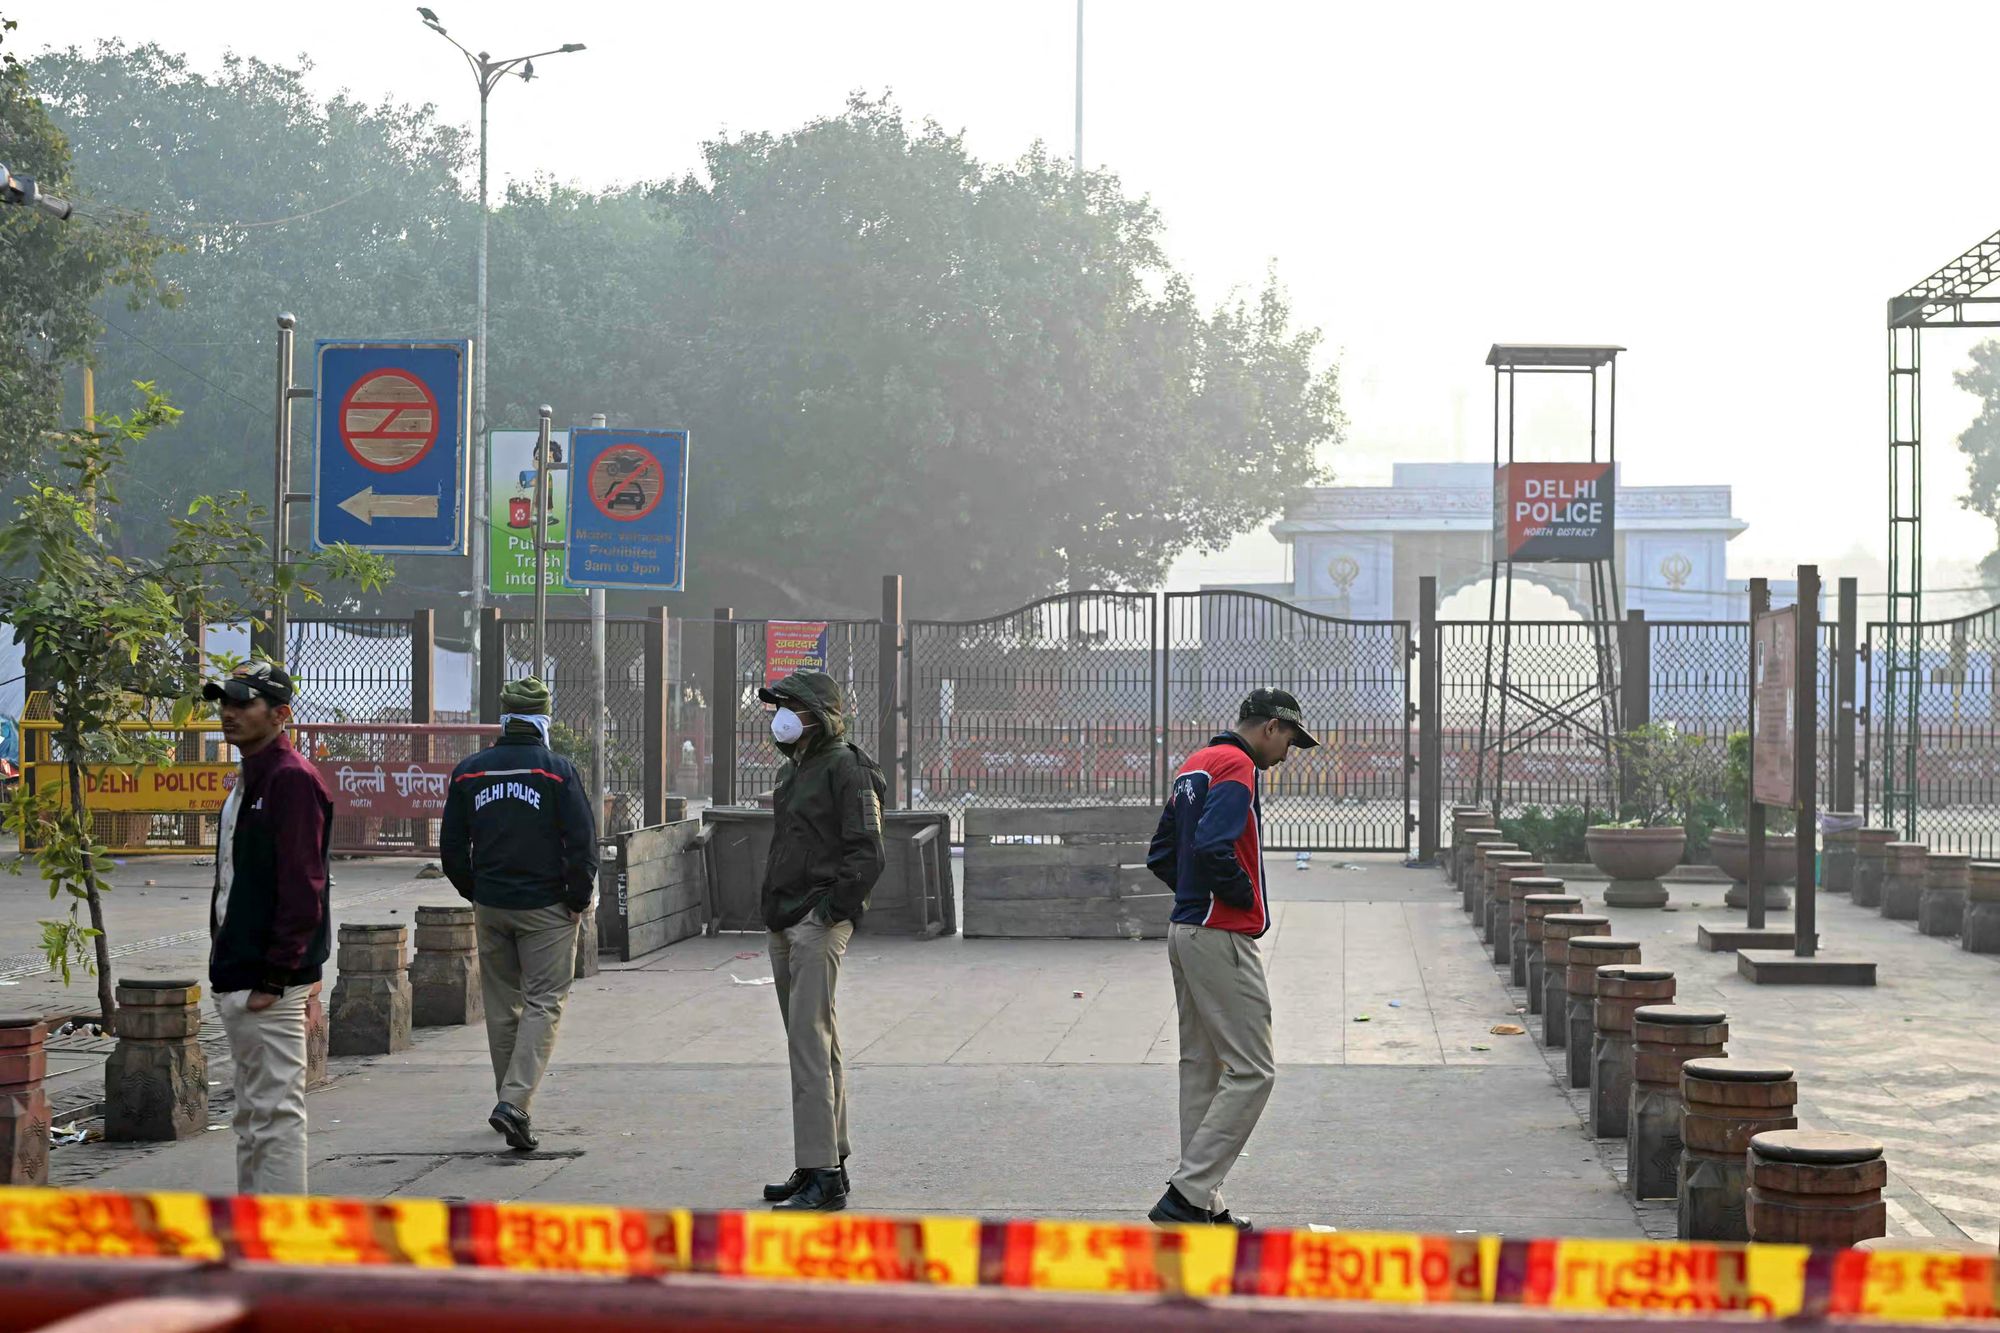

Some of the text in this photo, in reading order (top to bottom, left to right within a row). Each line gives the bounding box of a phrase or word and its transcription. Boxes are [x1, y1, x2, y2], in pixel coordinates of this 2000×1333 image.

[1525, 479, 1597, 499] DELHI
[1515, 502, 1603, 523] POLICE
[1523, 527, 1598, 537] NORTH DISTRICT
[584, 559, 661, 576] 9am to 9pm
[506, 572, 536, 585] into
[86, 773, 139, 793] DELHI
[154, 772, 218, 792] POLICE
[335, 764, 447, 798] दिल्ली पुलिस
[350, 799, 372, 808] NORTH
[475, 782, 541, 811] DELHI POLICE
[1302, 1244, 1480, 1289] POLICE
